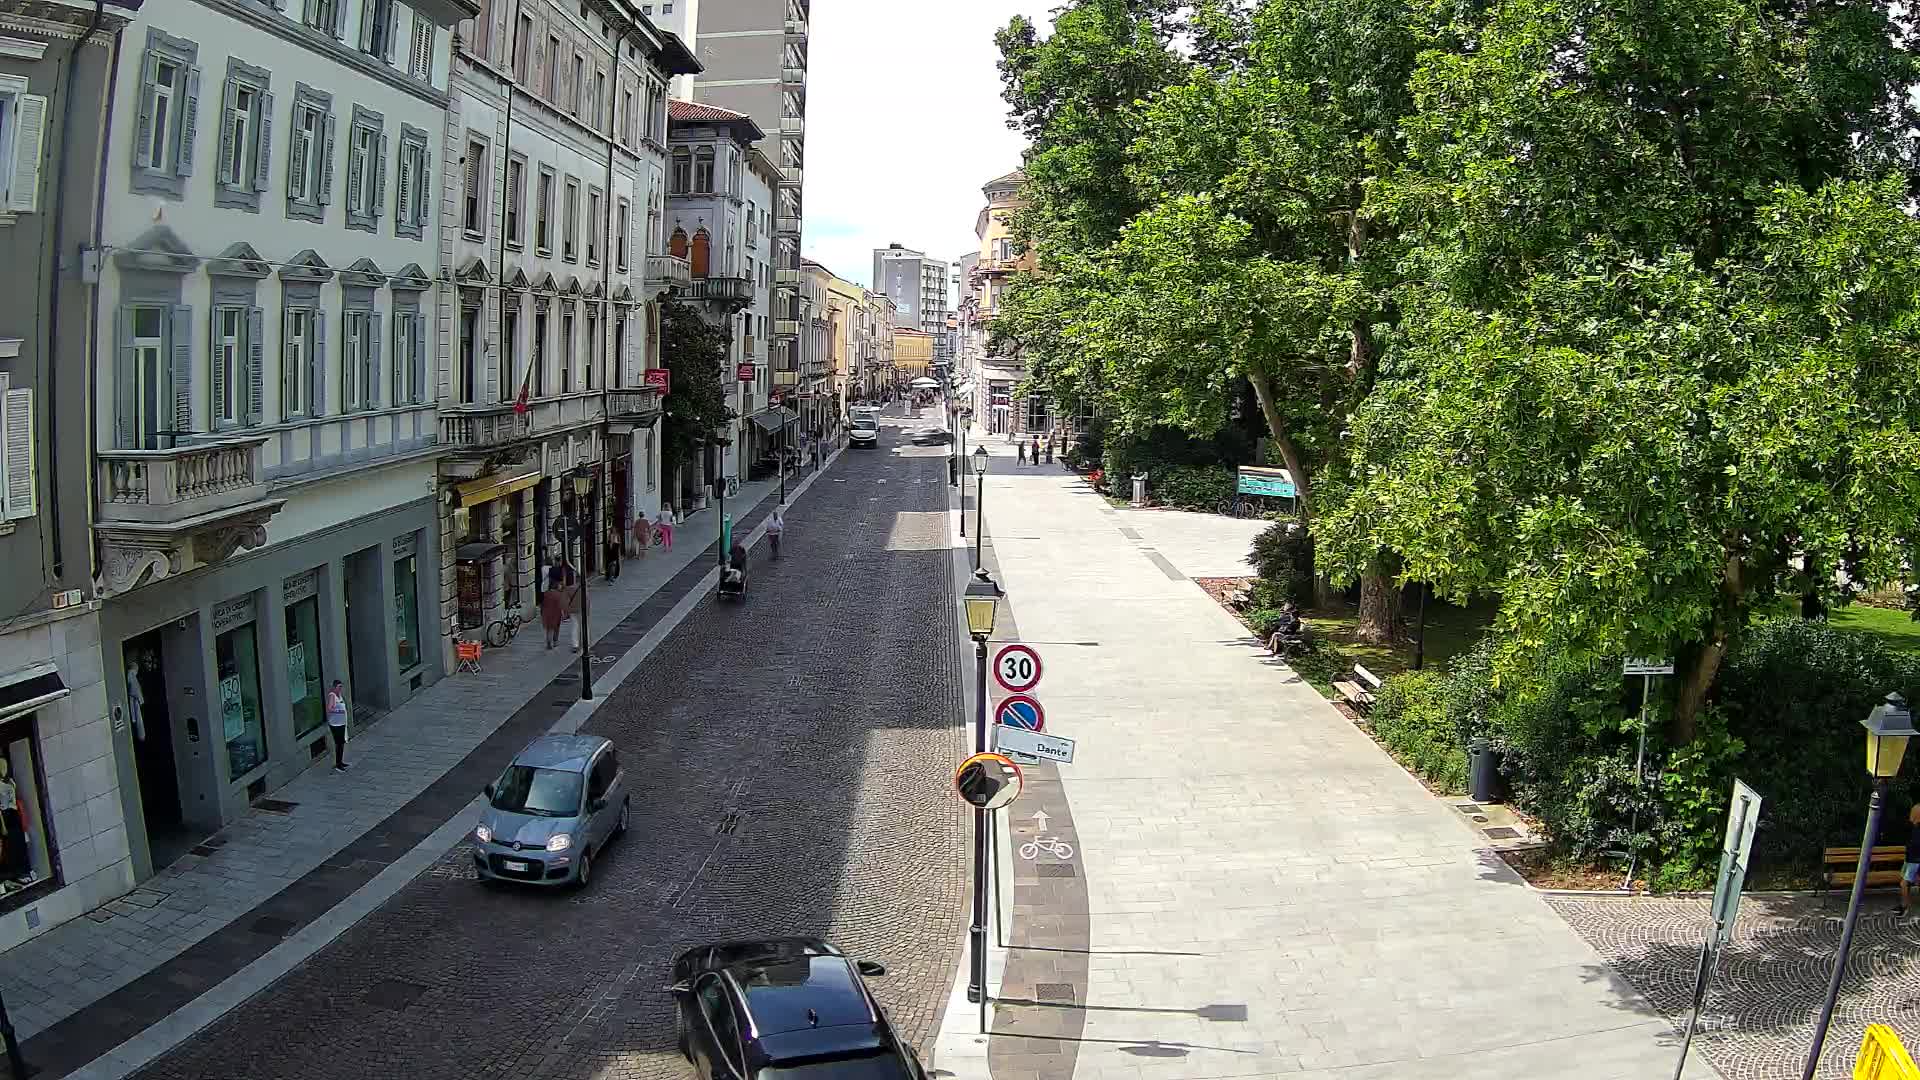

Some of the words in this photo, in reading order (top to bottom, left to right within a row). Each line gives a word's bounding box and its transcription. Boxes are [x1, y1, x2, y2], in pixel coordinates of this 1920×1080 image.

[1004, 657, 1032, 680] 30
[223, 678, 239, 701] 130
[1037, 743, 1068, 758] Dante
